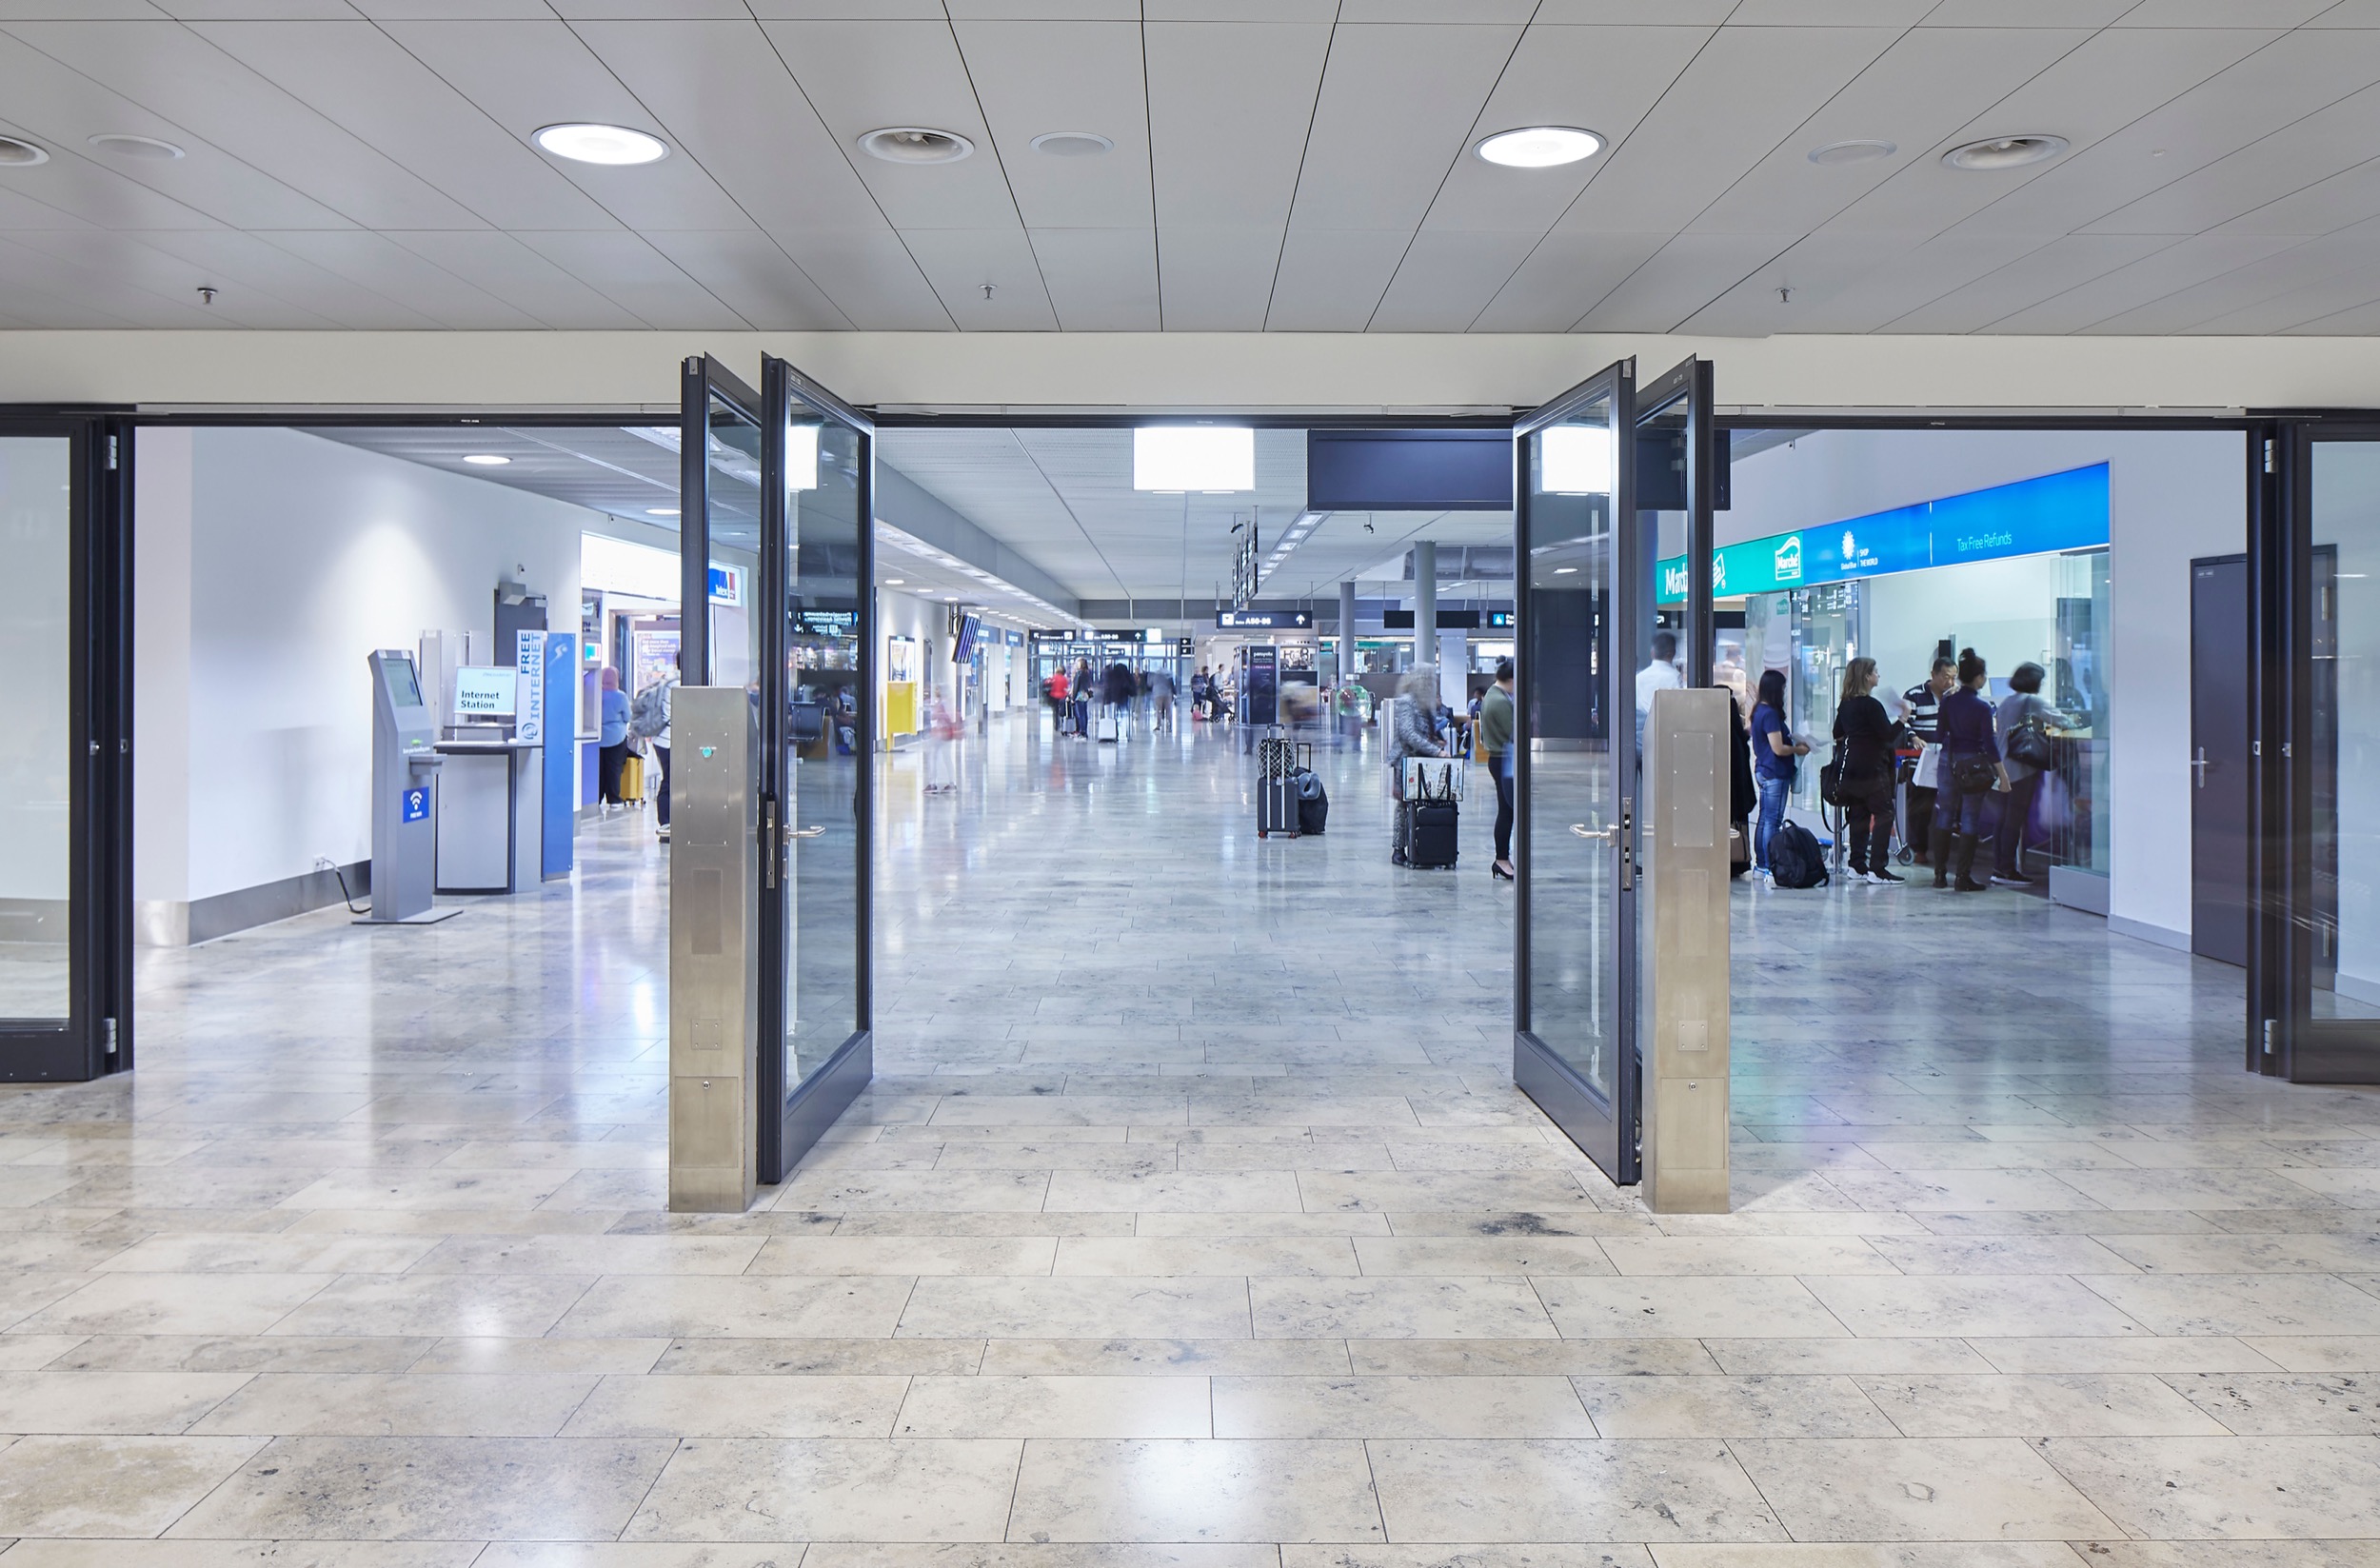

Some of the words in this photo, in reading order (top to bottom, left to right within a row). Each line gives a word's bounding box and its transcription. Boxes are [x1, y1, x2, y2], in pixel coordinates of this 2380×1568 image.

[1956, 538, 1968, 552] Tax
[1968, 536, 1984, 550] Free
[1984, 530, 2013, 548] Refunds
[1777, 553, 1798, 570] Marché
[521, 632, 530, 674] FREE
[530, 632, 541, 720] INTERNET
[461, 690, 500, 700] Internet
[461, 700, 495, 709] Station
